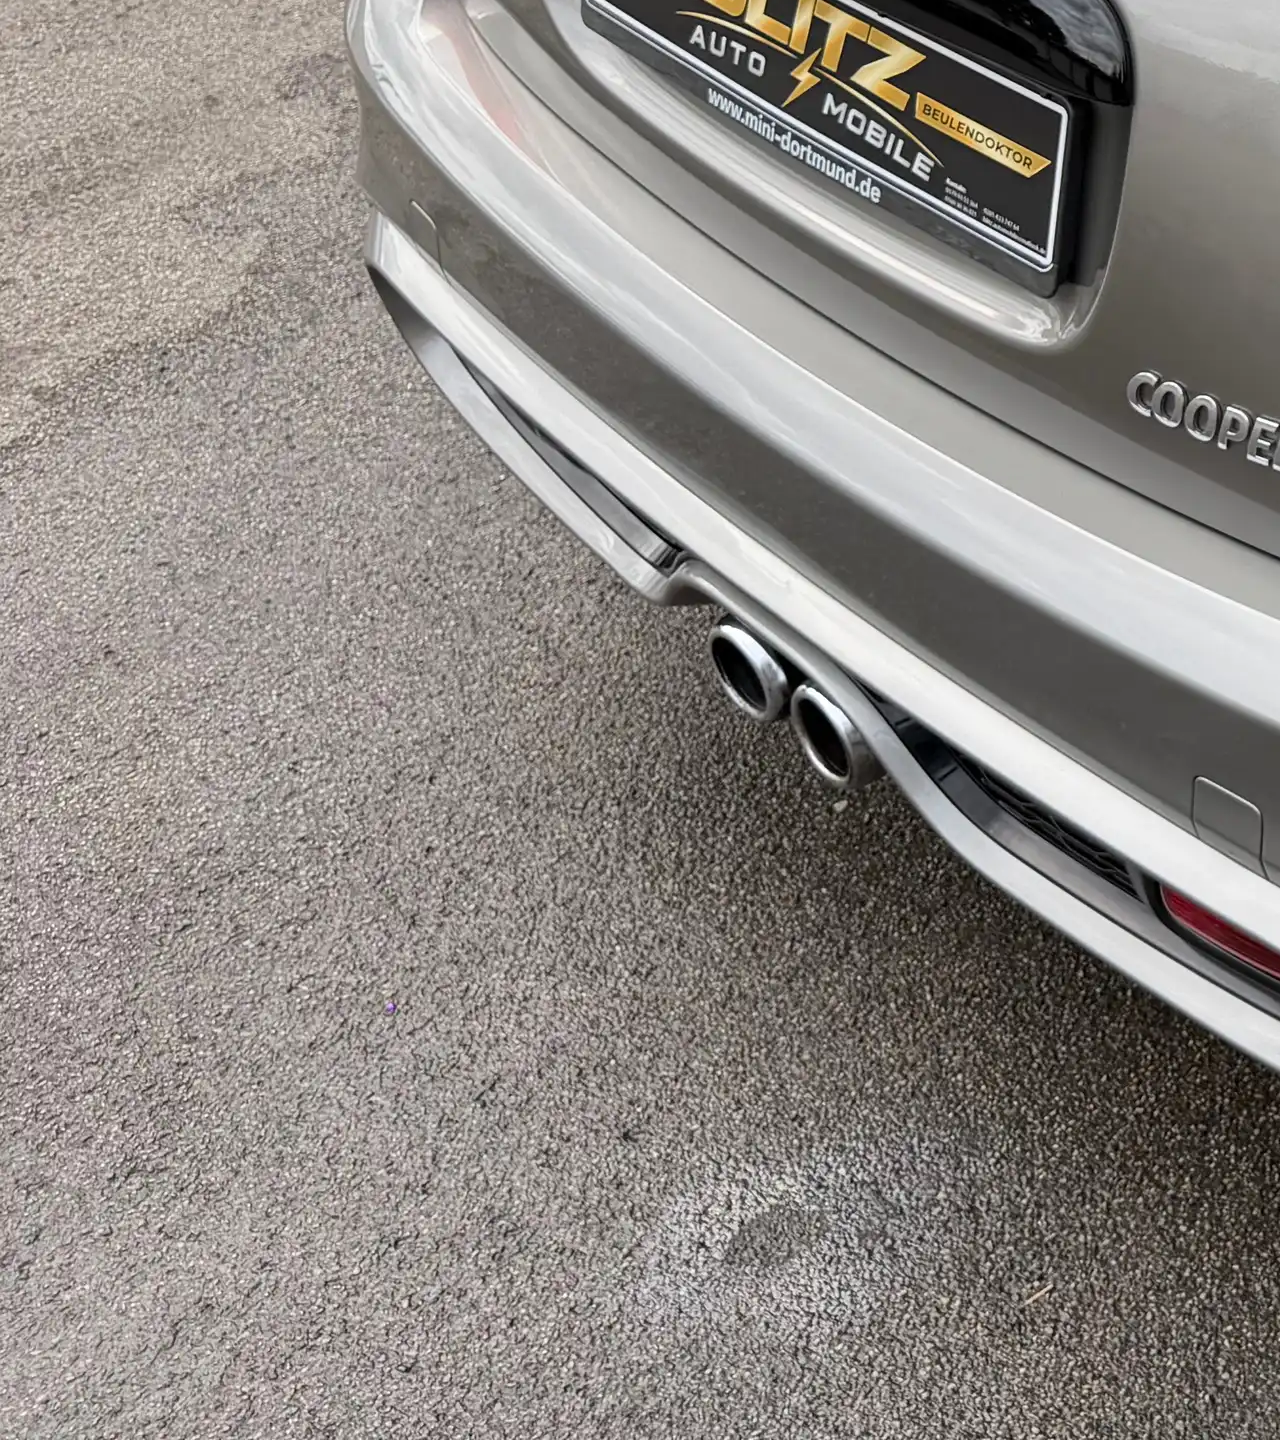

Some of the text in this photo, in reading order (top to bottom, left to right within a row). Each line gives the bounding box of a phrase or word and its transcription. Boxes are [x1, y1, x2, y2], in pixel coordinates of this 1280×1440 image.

[689, 25, 935, 182] AUTO MOBILE
[707, 86, 882, 203] www.mini-dortmund.de
[922, 103, 1034, 170] BEULENDOKTOR
